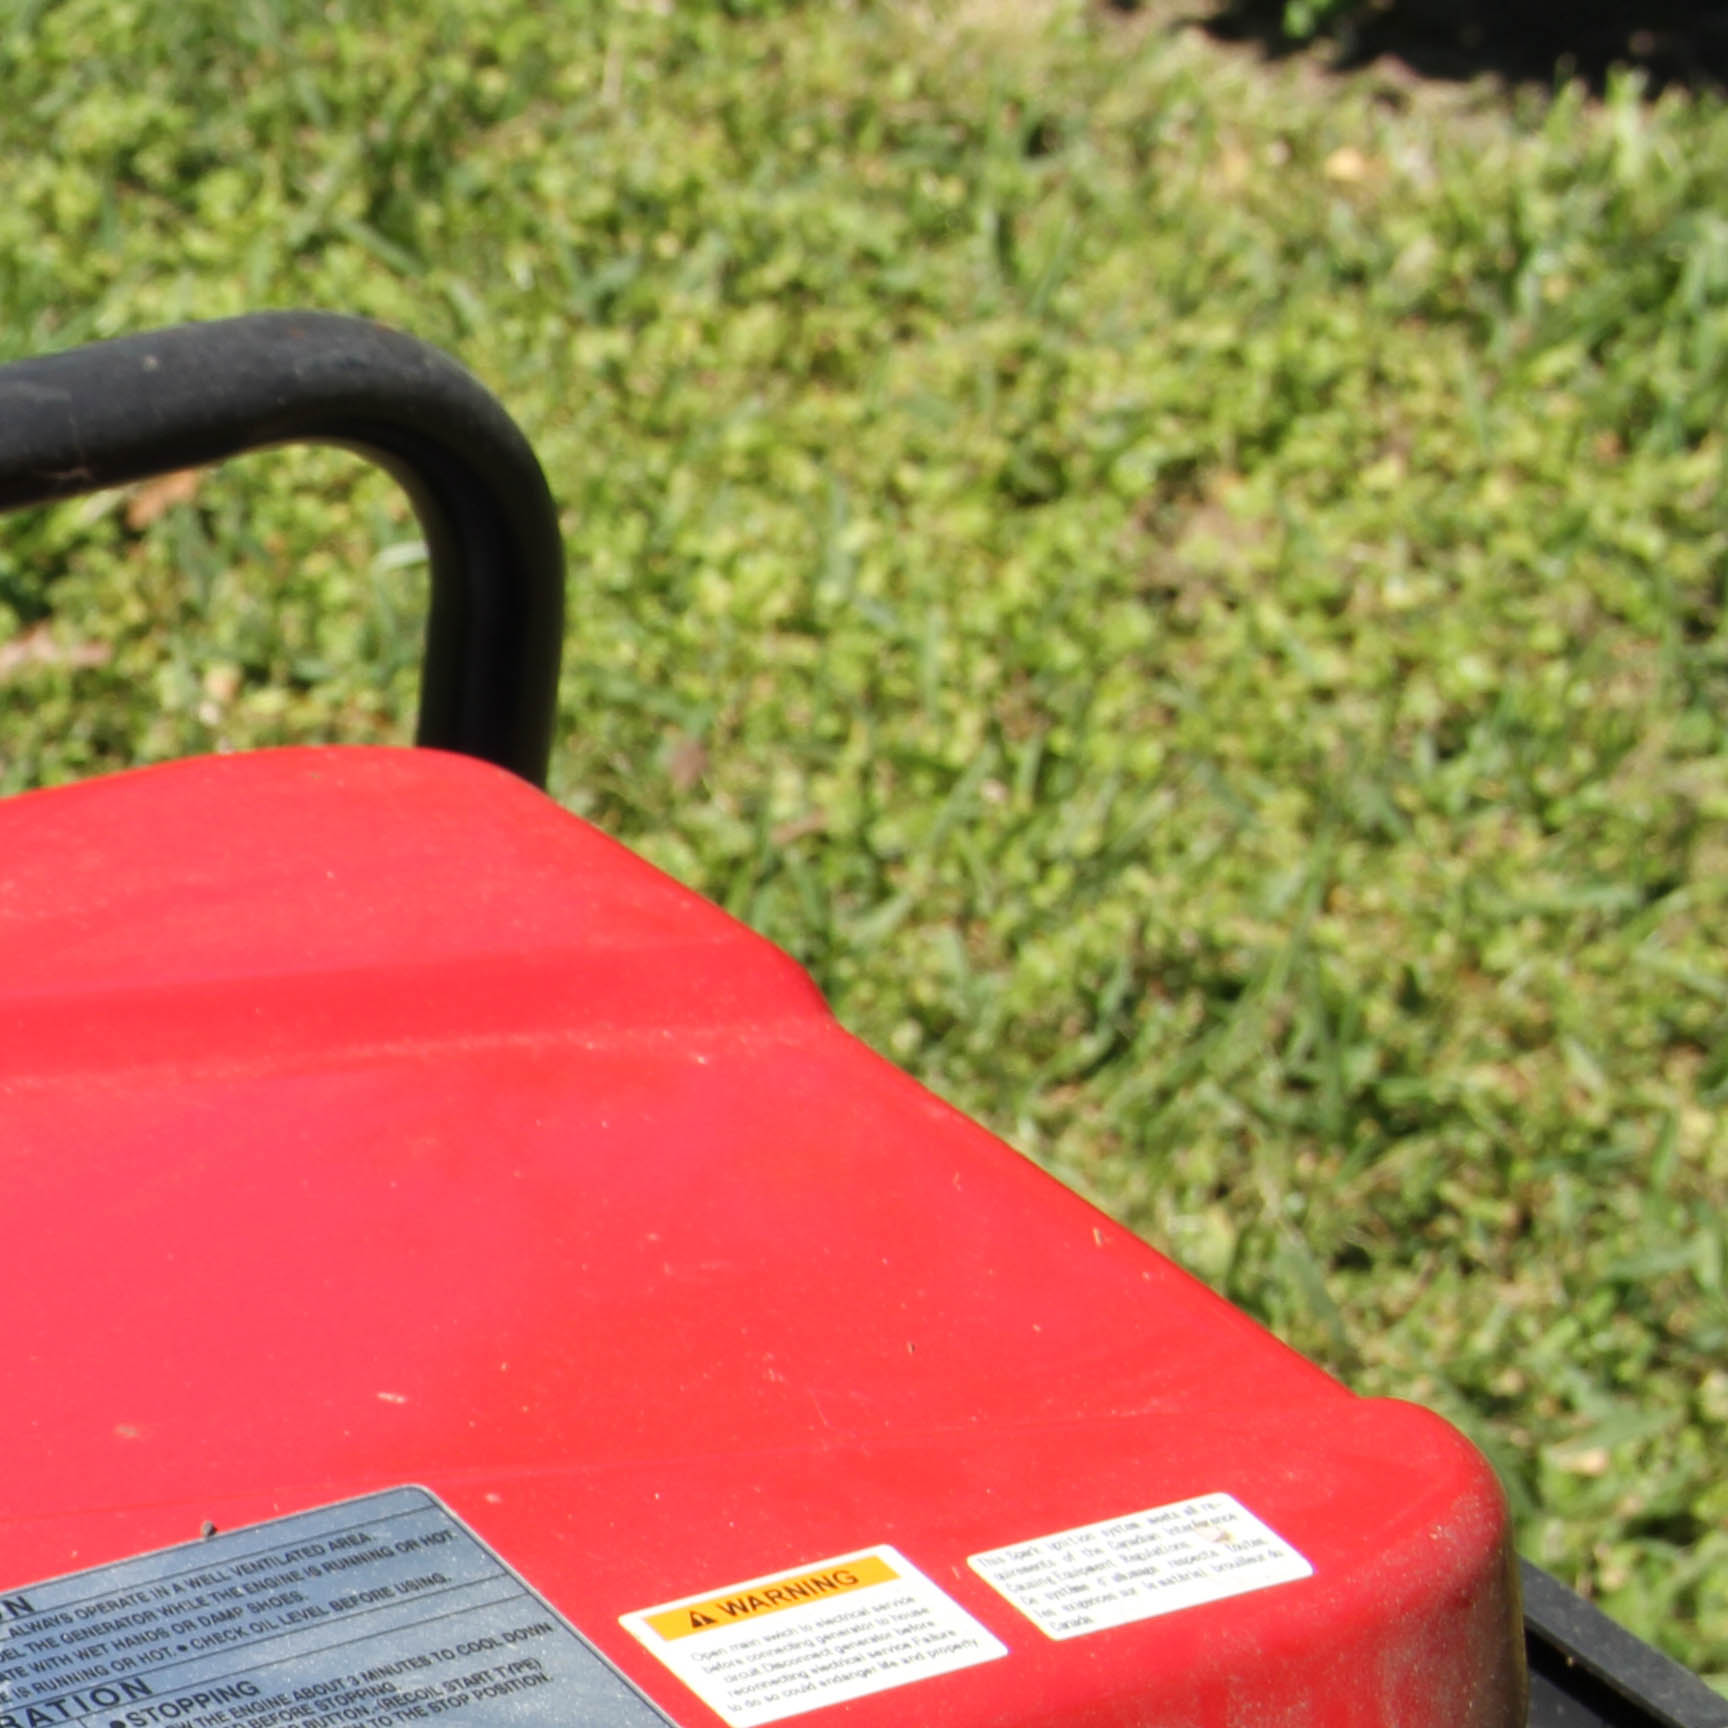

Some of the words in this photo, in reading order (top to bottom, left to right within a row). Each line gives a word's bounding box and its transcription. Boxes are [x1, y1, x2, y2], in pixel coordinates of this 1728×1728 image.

[73, 1591, 151, 1621] OPERATE
[149, 1585, 171, 1600] IN
[171, 1582, 187, 1595] A
[183, 1570, 233, 1590] WELL
[235, 1544, 327, 1577] VENTILATED
[718, 1572, 859, 1617] WARNING
[11, 1686, 32, 1700] IS
[30, 1664, 111, 1695] RUNNING
[109, 1656, 139, 1673] OR
[189, 1625, 250, 1651] CHECK
[248, 1619, 280, 1634] OIL
[276, 1605, 330, 1626] LEVEL
[328, 1586, 395, 1613] BEFORE
[27, 1653, 74, 1674] WITH
[71, 1642, 110, 1662] WET
[110, 1627, 171, 1652] HANDS
[170, 1619, 198, 1636] OR
[196, 1606, 244, 1628] DAMP
[125, 1680, 261, 1728] STOPPING
